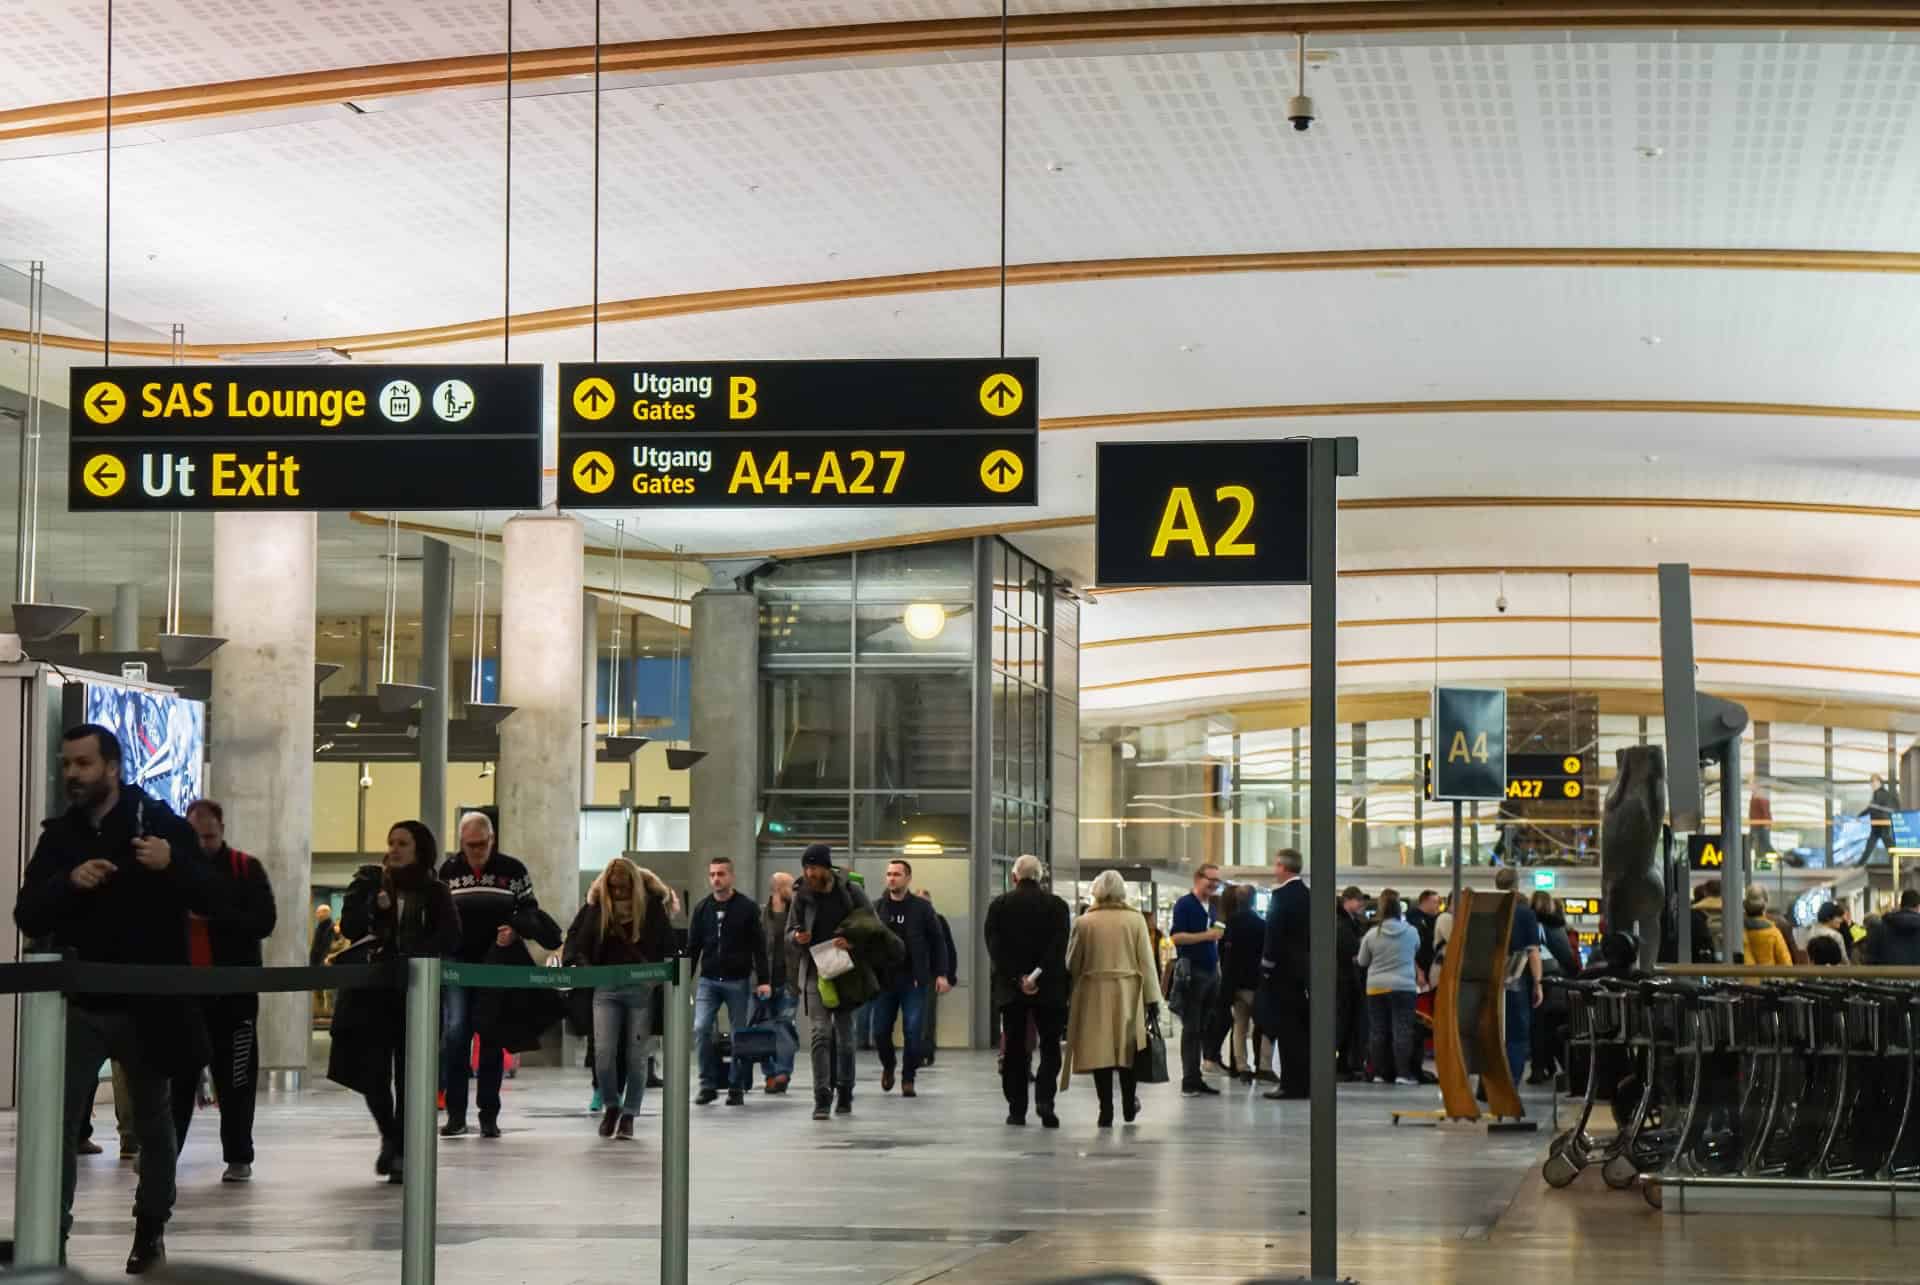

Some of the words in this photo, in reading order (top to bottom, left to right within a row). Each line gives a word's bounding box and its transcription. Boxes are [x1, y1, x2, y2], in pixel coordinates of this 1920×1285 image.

[633, 373, 712, 397] Utgang
[729, 376, 757, 419] B
[142, 382, 213, 417] SAS
[228, 382, 366, 427] Lounge
[632, 399, 695, 420] Gates
[142, 453, 195, 496] Ut
[212, 451, 300, 496] Exit
[633, 446, 712, 472] Utgang
[728, 450, 905, 494] A4-A27
[632, 473, 695, 493] Gates
[1151, 486, 1256, 557] A2
[1448, 730, 1489, 764] A4
[1700, 843, 1723, 866] A
